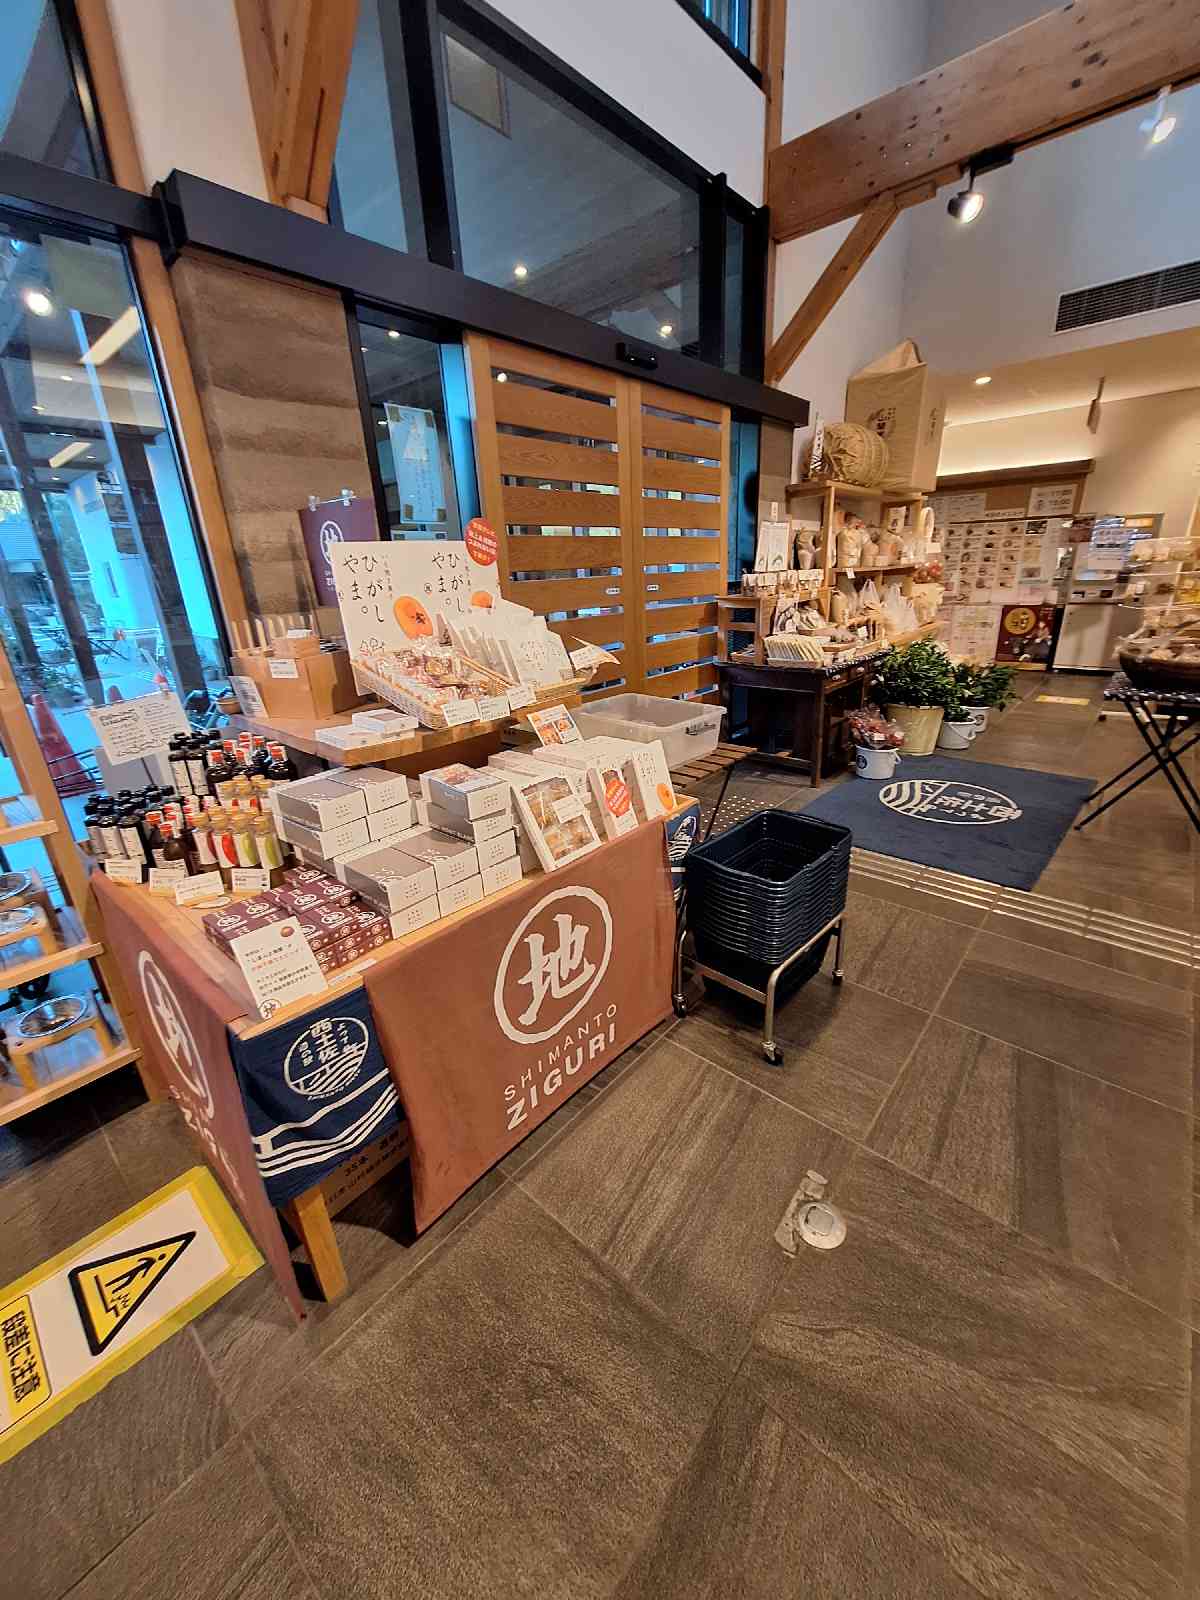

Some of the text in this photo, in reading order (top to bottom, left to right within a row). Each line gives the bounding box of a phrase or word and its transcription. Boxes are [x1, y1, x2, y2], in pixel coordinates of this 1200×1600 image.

[361, 555, 385, 623] ひがし
[447, 553, 465, 613] ひがし
[309, 1017, 340, 1064] 西土佐
[504, 1003, 617, 1101] SHIMANTO
[506, 1022, 616, 1131] ZIGURI
[1, 1309, 42, 1404] 段差に注意
